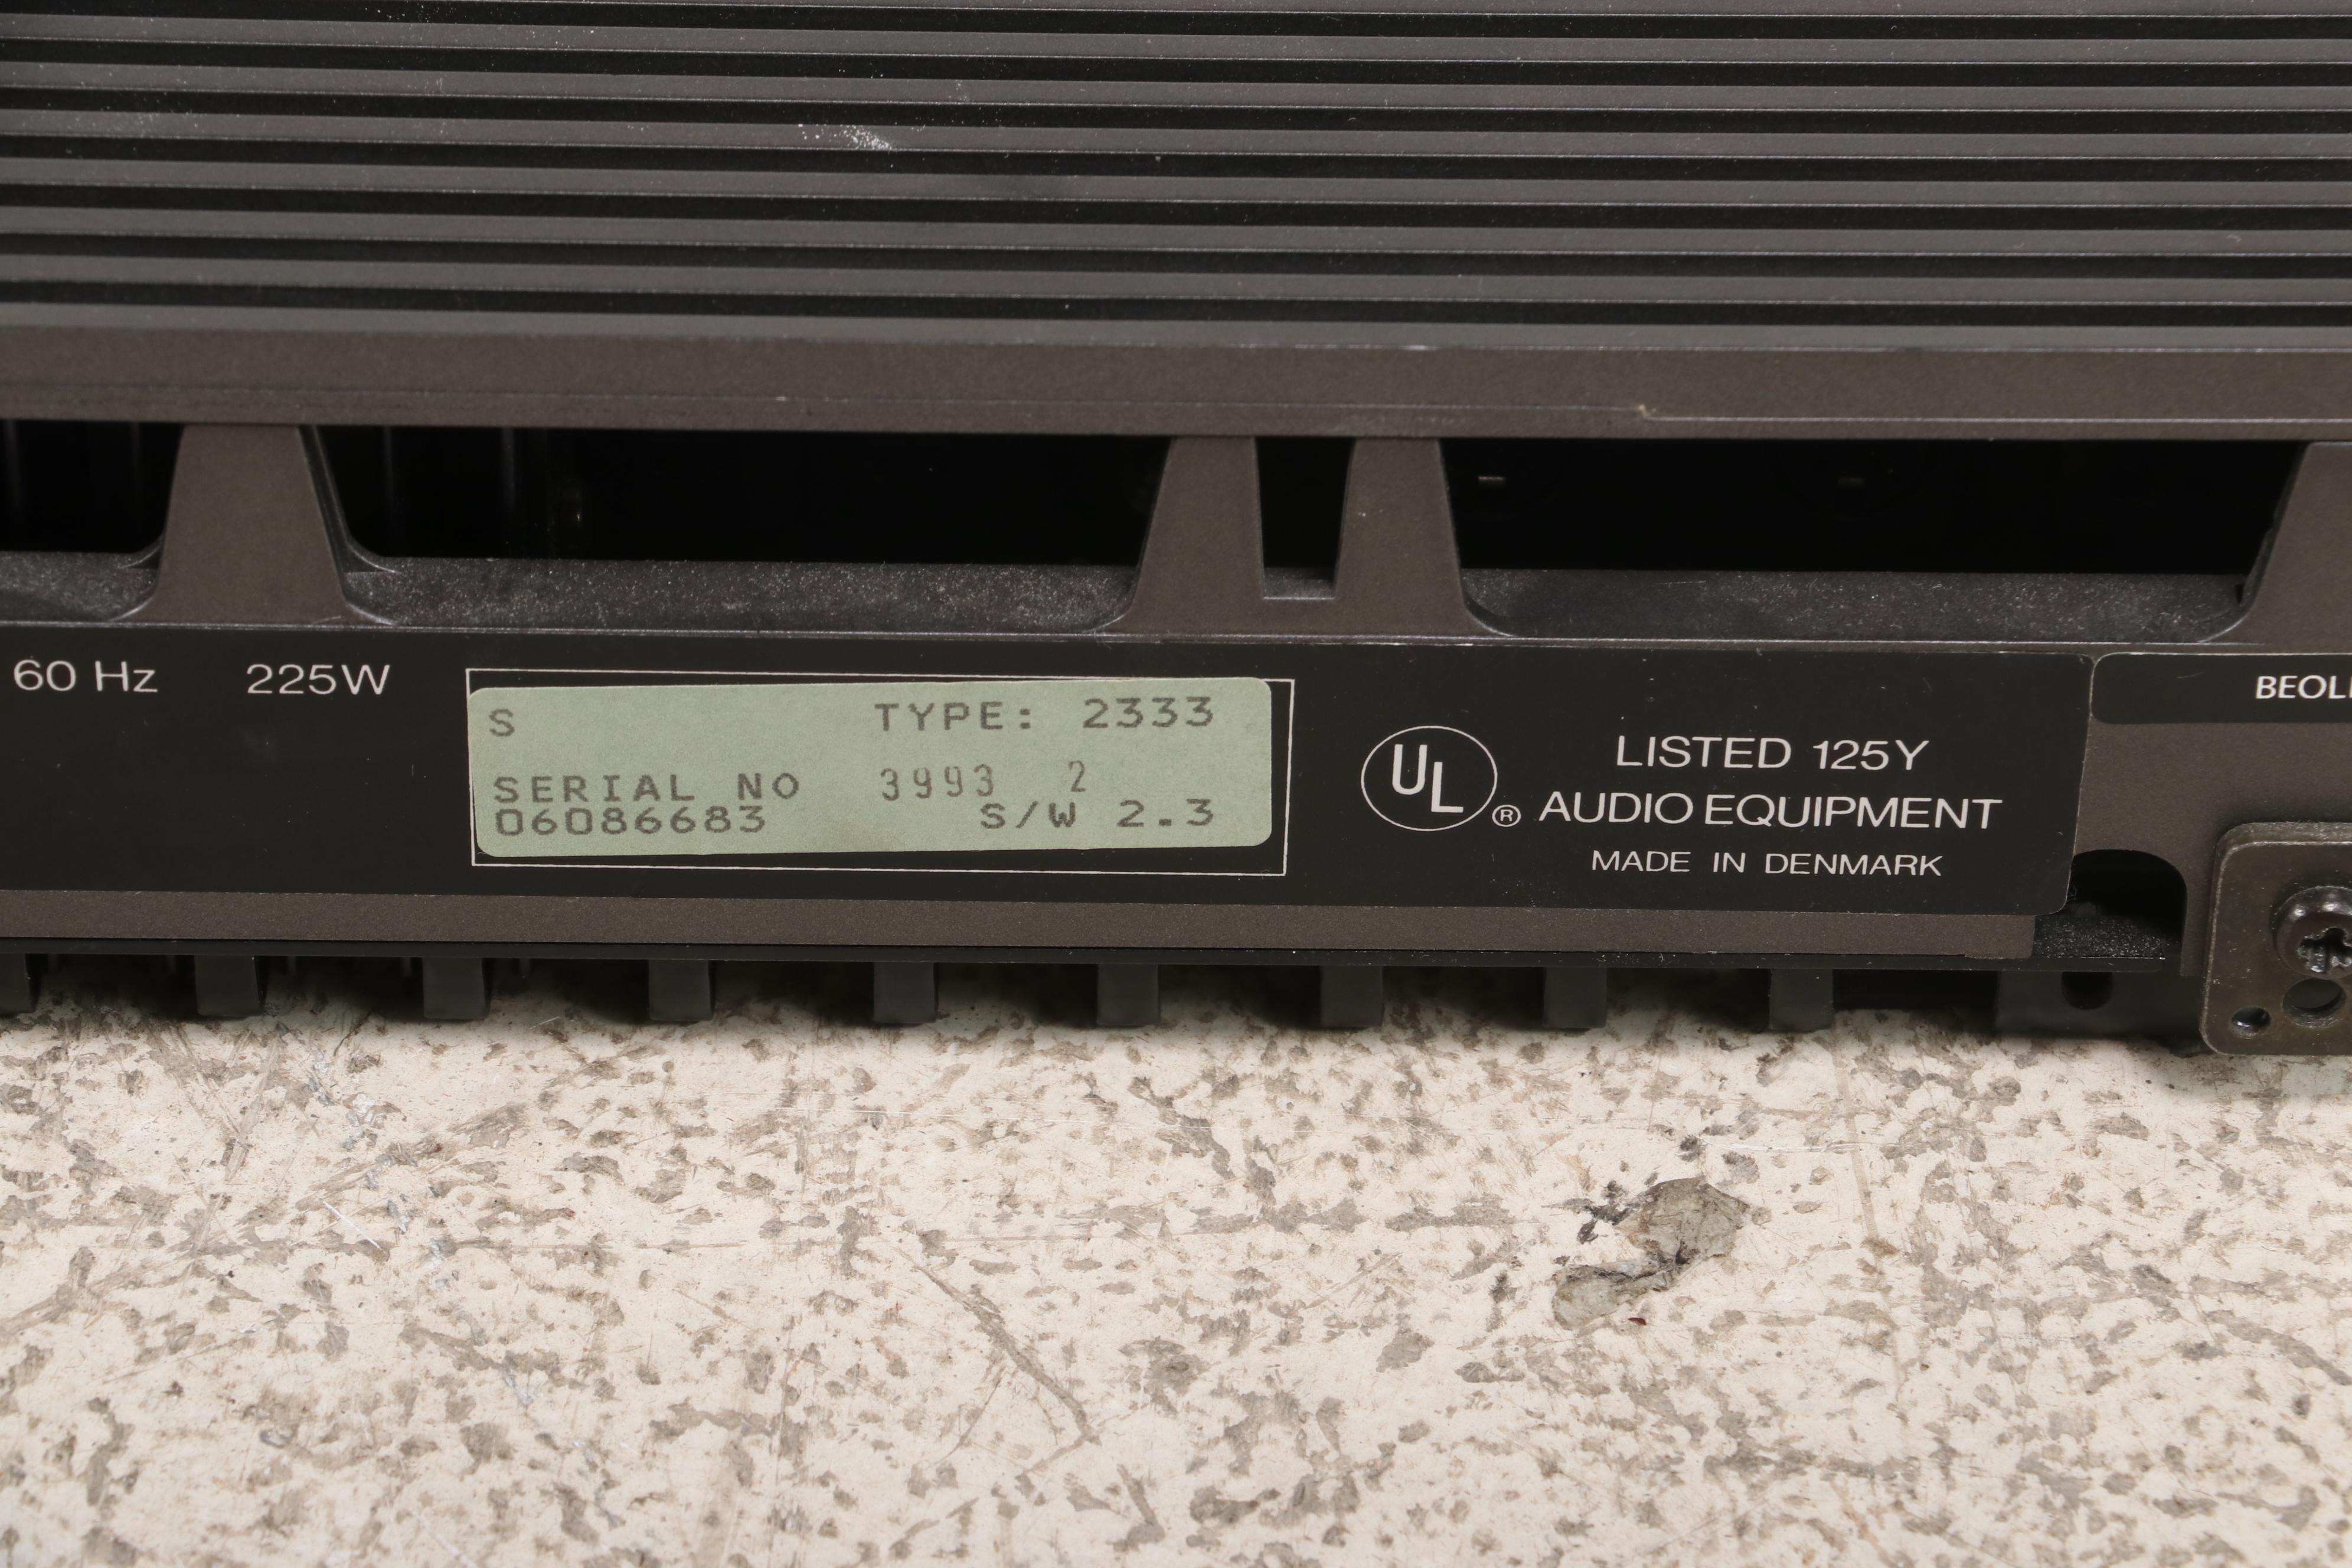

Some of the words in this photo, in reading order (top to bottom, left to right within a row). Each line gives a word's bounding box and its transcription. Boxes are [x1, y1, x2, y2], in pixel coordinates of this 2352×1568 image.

[13, 658, 77, 692] 60
[94, 660, 158, 693] Hz
[246, 663, 391, 695] 225W
[2255, 674, 2352, 700] BEOL
[488, 707, 516, 738] S
[873, 700, 1031, 733] TYPE:
[1082, 695, 1214, 730] 2333
[1616, 734, 1792, 769] LISTED
[1812, 739, 1930, 771] 125Y
[492, 773, 695, 805] SERIAL
[737, 772, 800, 801] NO
[879, 763, 995, 801] 3993
[1067, 759, 1087, 793] 2
[1391, 743, 1465, 814] UL
[494, 804, 766, 837] 06086683
[979, 800, 1077, 830] S/W
[1116, 798, 1214, 828] 2.3
[1538, 790, 1694, 825] AUDIO
[1704, 793, 2004, 830] EQUIPMENT
[1591, 849, 1692, 873] MADE
[1712, 851, 1746, 874] IN
[1764, 852, 1943, 877] DENMARK
